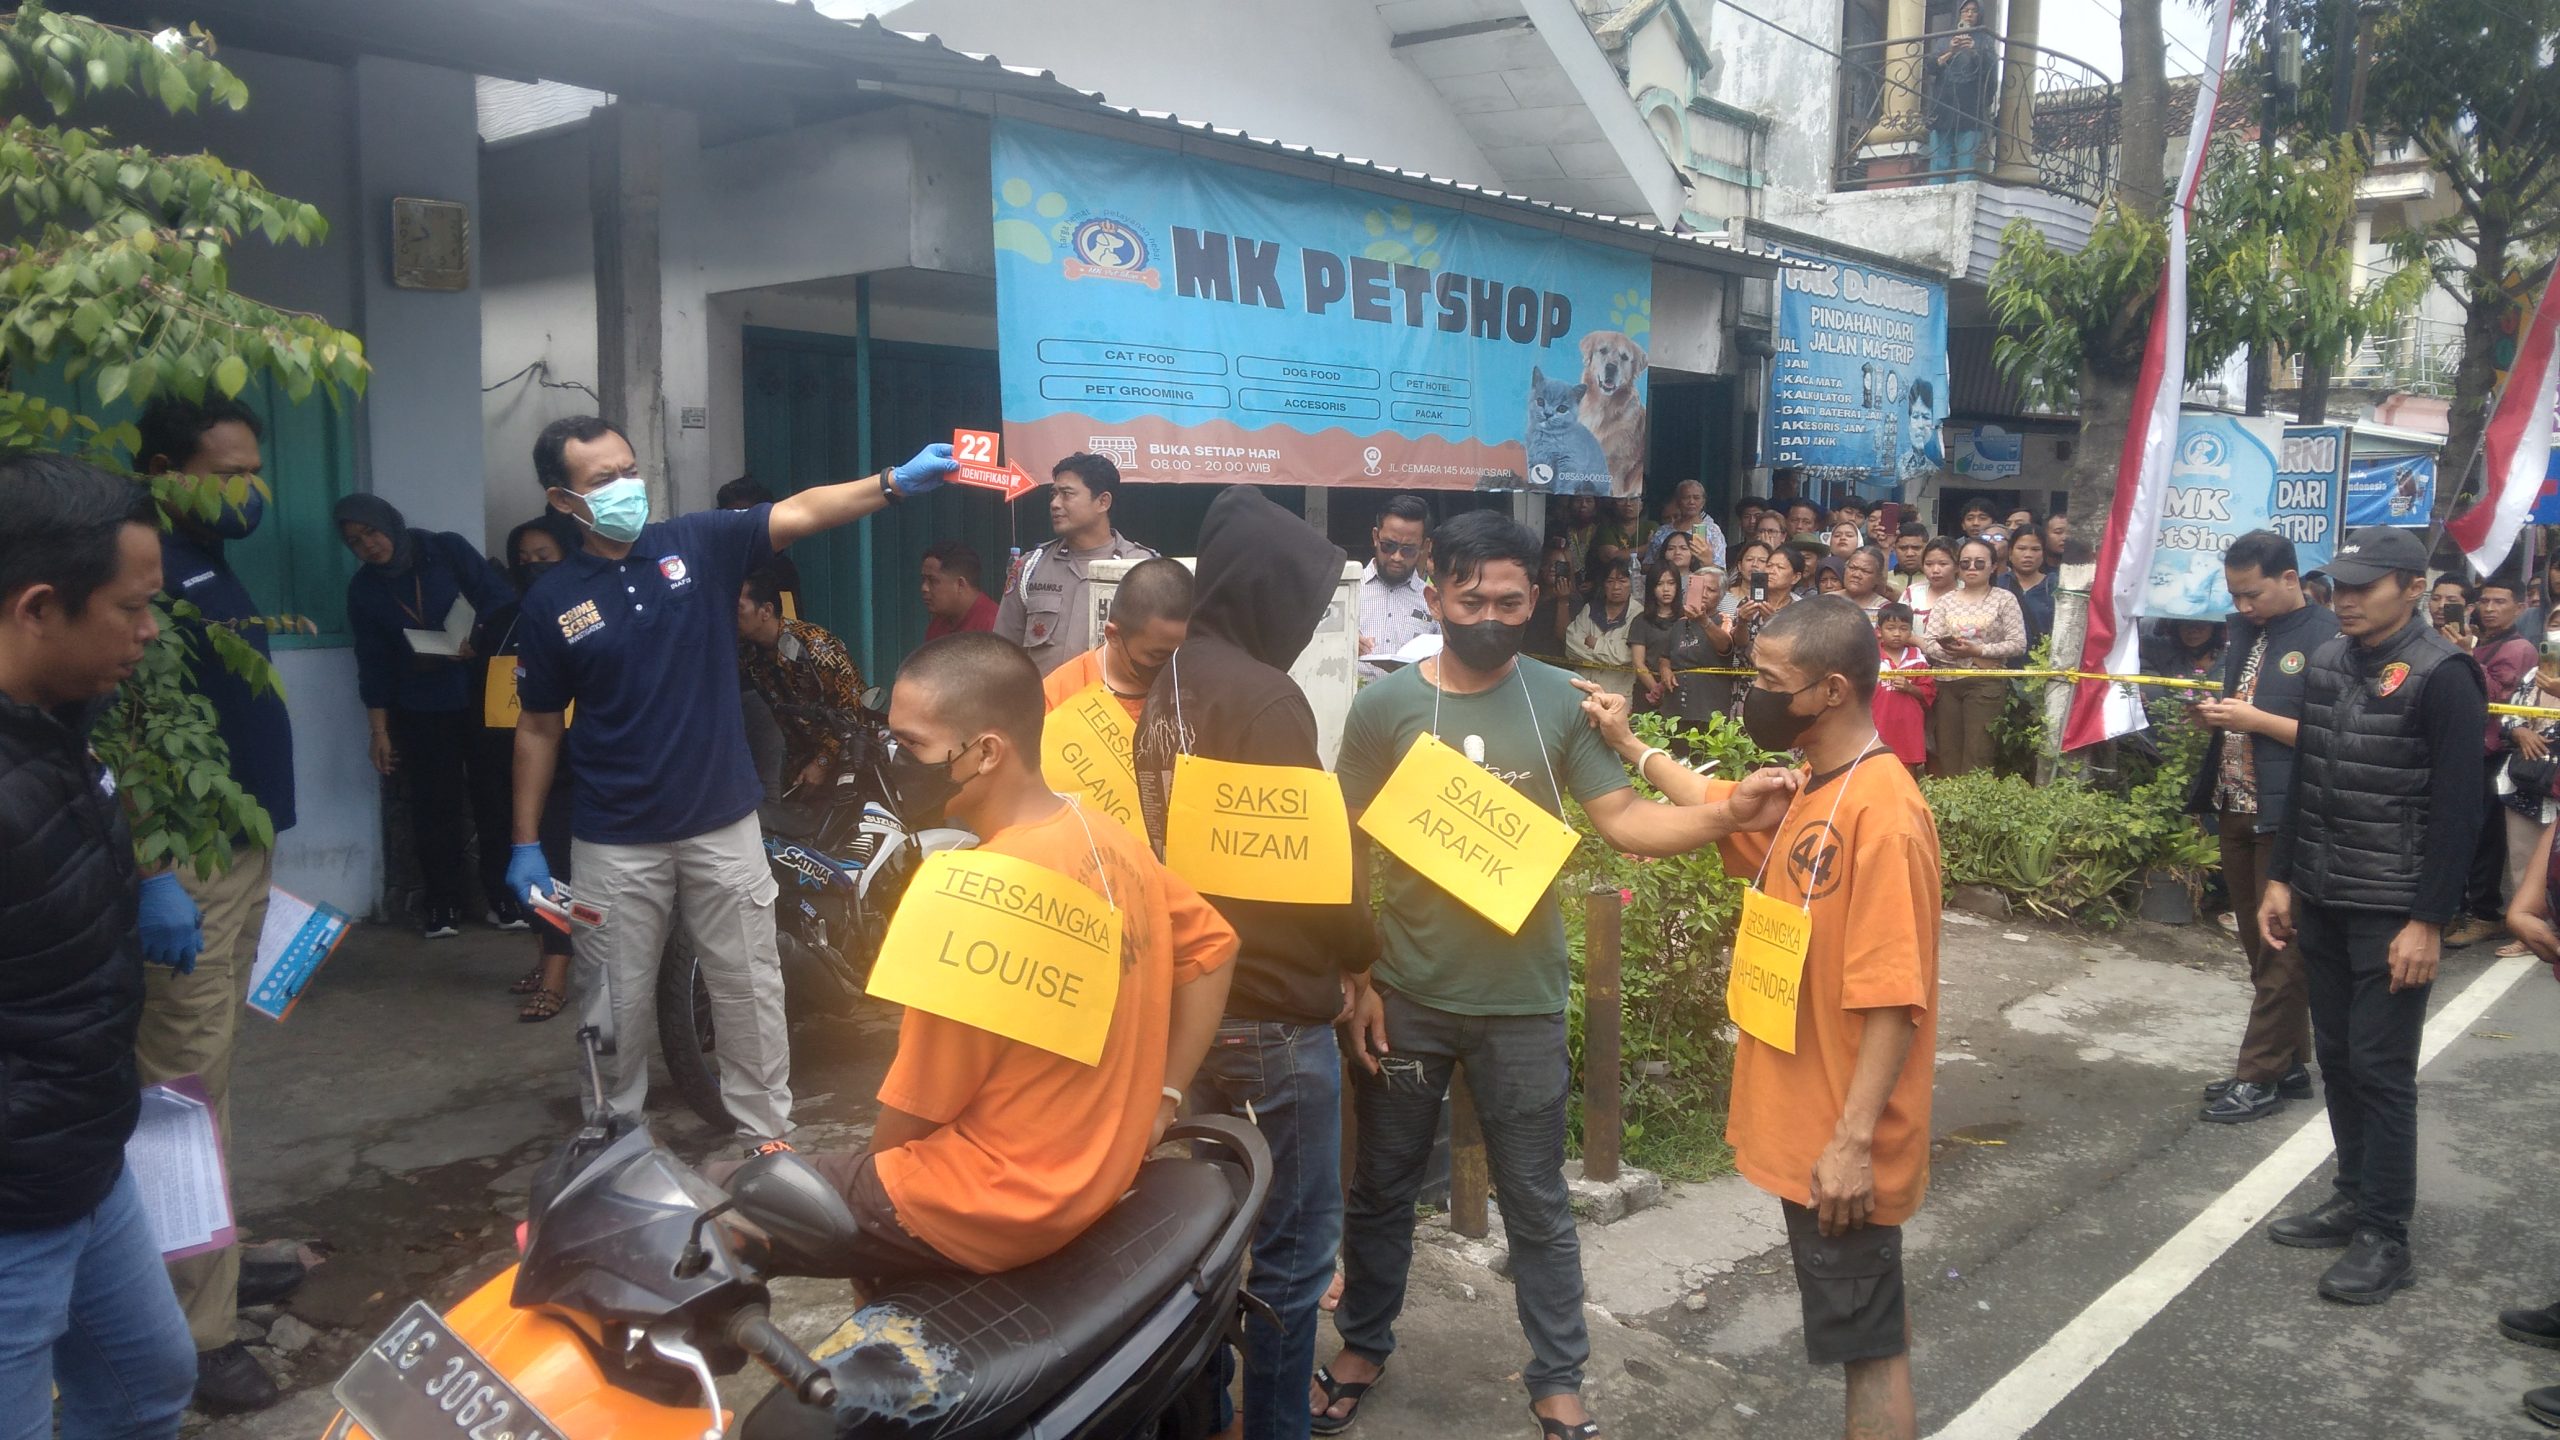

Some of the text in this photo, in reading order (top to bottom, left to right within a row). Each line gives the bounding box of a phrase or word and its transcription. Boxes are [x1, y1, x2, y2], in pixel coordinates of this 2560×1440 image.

[1170, 224, 1572, 348] MK PETSHOP
[1811, 306, 1914, 343] PINDAHAN DARI
[1104, 350, 1175, 365] CAT FOOD
[1809, 332, 1914, 365] JALAN MASTRIP
[1282, 367, 1341, 381] DOG FOOD
[1785, 359, 1809, 369] JAM
[1085, 384, 1194, 401] PET GROOMING
[1406, 379, 1451, 392] PET HOTEL
[1816, 378, 1843, 388] MATA
[1284, 398, 1347, 412] ACCESORIS
[1783, 390, 1853, 404] KALKULATOR
[1415, 409, 1443, 420] PACAK
[1843, 424, 1867, 434] JAM
[959, 433, 992, 463] 22
[1149, 443, 1281, 459] BUKA SETIAP HARI
[961, 467, 1009, 485] IDENTIFIKASI
[1150, 459, 1192, 471] 08.00
[1246, 462, 1271, 473] WIB
[1401, 463, 1442, 474] CEMARA
[1443, 465, 1458, 475] 145
[1972, 462, 1994, 472] blue
[2162, 486, 2231, 521] MK
[2276, 479, 2328, 509] DARI
[558, 599, 597, 626] CRIME
[562, 610, 602, 638] SCENE
[1084, 697, 1136, 772] TERSA
[1061, 742, 1131, 825] GILANG
[1215, 782, 1308, 814] SAKSI
[1444, 775, 1531, 843] SAKSI
[863, 815, 902, 832] SUZUKI
[1211, 827, 1309, 861] NIZAM
[1409, 808, 1515, 886] ARAFIK
[1791, 832, 1839, 887] 44
[945, 867, 1111, 949] TERSANGKA
[937, 930, 1085, 1008] LOUISE
[425, 1356, 510, 1440] 3062
